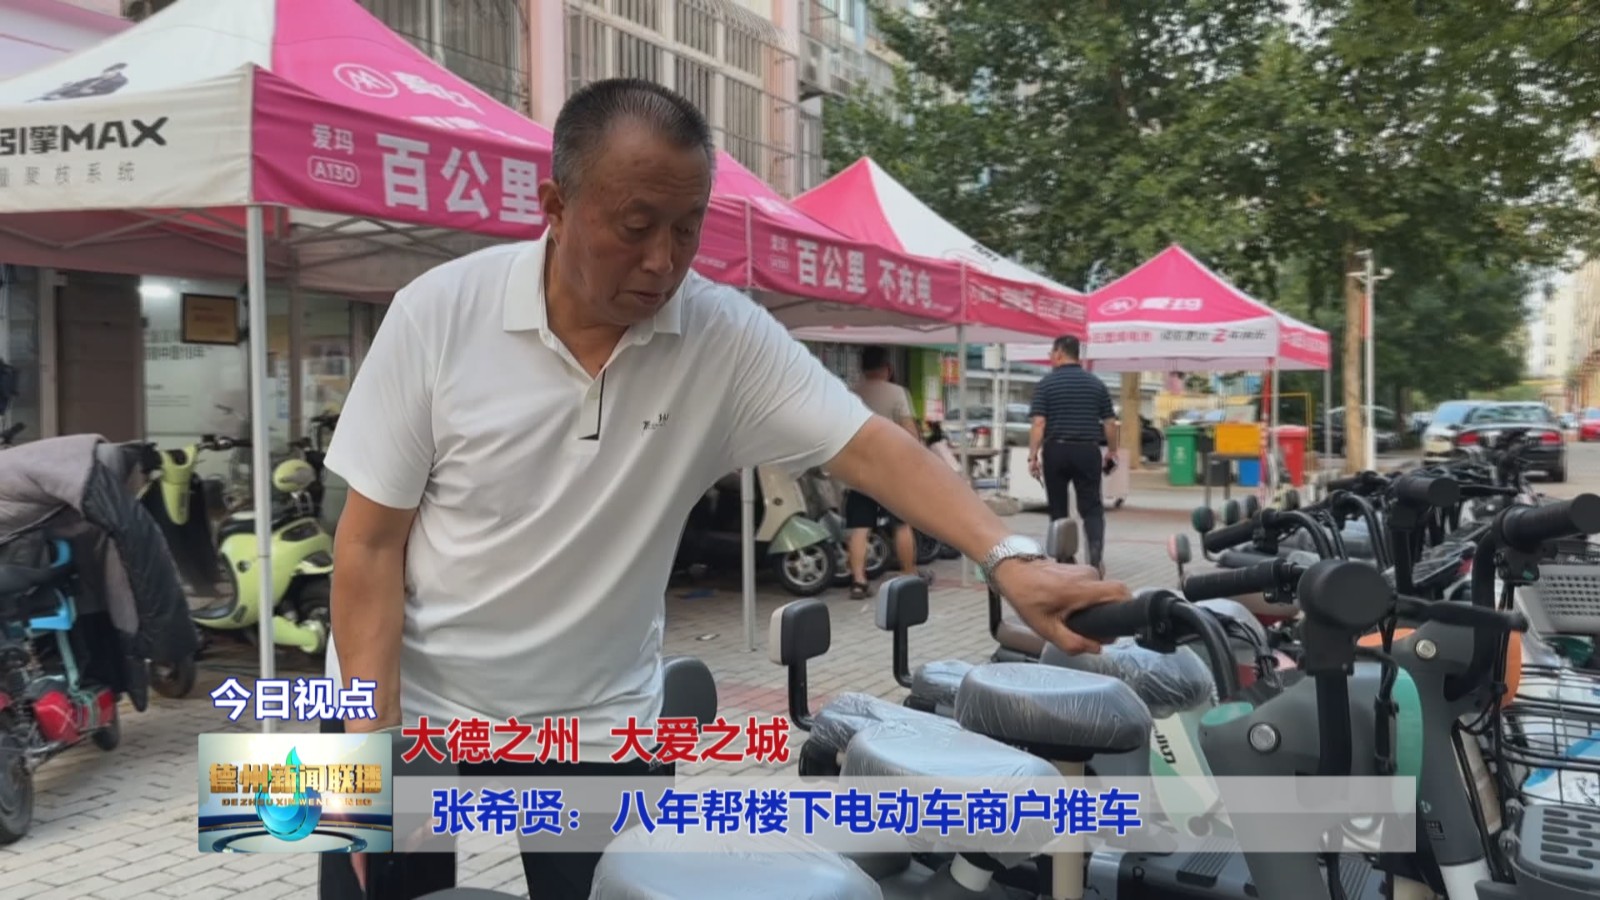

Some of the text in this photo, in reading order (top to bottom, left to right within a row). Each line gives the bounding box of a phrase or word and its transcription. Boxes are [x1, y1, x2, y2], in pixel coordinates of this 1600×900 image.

[0, 116, 168, 156] 引擎MAX
[312, 124, 354, 154] 爱玛
[314, 161, 356, 183] A130
[376, 132, 544, 225] 百公里
[796, 238, 867, 295] 百公里
[878, 258, 933, 310] 不充电
